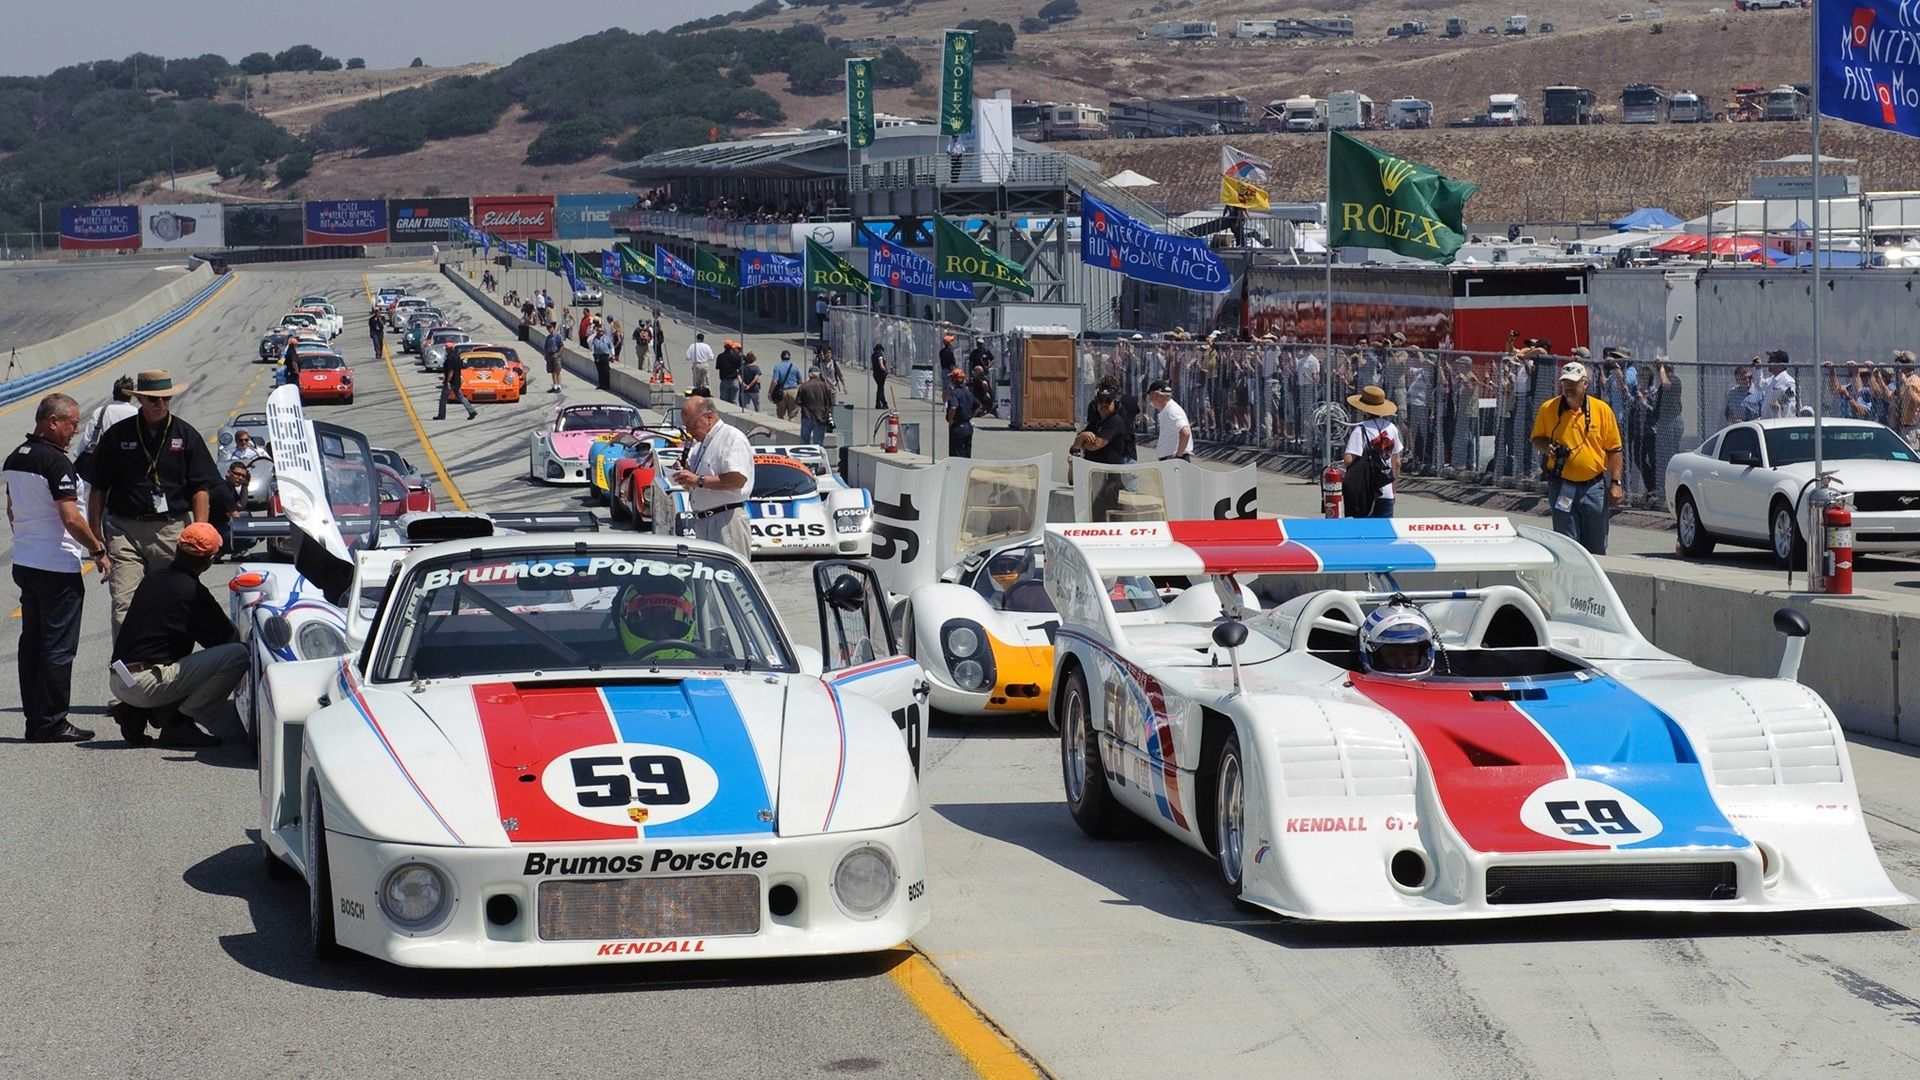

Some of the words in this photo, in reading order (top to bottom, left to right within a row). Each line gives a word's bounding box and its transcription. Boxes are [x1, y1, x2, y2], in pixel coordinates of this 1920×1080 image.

[952, 54, 964, 113] ROLEX
[1843, 66, 1920, 108] AUTOMO
[857, 79, 866, 130] ROLEX
[396, 218, 421, 229] GRAN
[424, 217, 449, 229] TURIS
[482, 210, 545, 227] Edelbrock
[1088, 218, 1150, 247] MONTEREY
[1342, 202, 1446, 248] ROLEX
[945, 255, 1027, 288] ROLEX
[1171, 255, 1221, 283] RACES
[837, 509, 866, 517] BOSCH
[750, 523, 826, 537] ACHS
[838, 525, 864, 533] SACH
[871, 493, 920, 564] 16
[1409, 523, 1467, 532] KENDALL
[1473, 523, 1500, 531] GT-1
[422, 559, 576, 591] Brumos
[587, 557, 737, 584] Porsche
[1570, 597, 1606, 617] GOODYEAR
[570, 755, 691, 808] 59
[1286, 816, 1368, 833] KENDALL
[1545, 800, 1642, 836] 59
[523, 852, 644, 876] Brumos
[651, 846, 769, 872] Porsche
[907, 879, 925, 902] BOSCH
[340, 897, 365, 920] BOSCH
[596, 940, 705, 956] KENDALL
